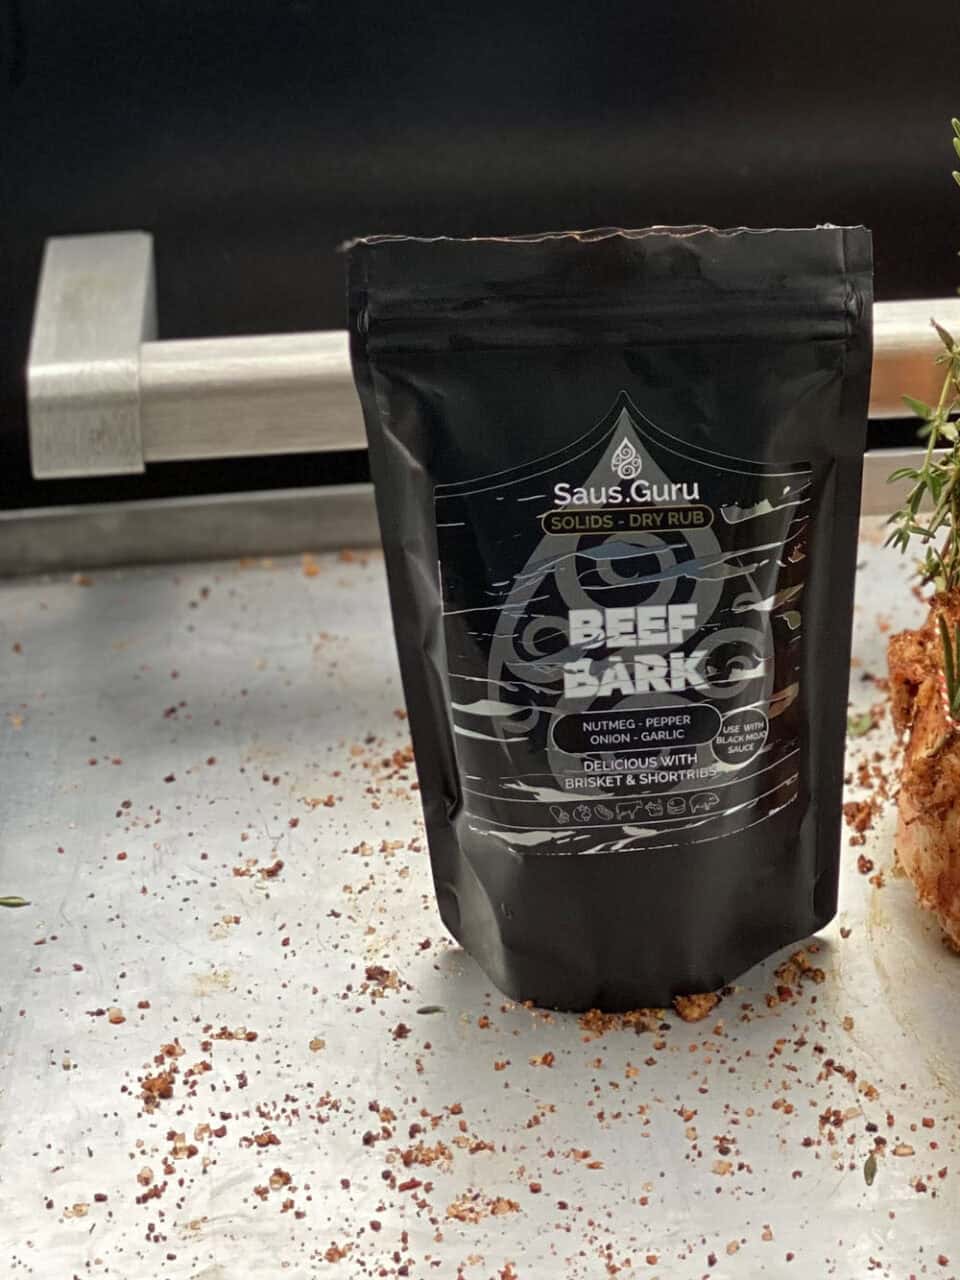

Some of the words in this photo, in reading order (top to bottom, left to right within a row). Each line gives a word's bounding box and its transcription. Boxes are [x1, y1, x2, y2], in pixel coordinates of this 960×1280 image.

[554, 479, 700, 505] Saus.Guru
[551, 514, 614, 530] SOLIDS
[629, 512, 665, 528] DRY
[668, 511, 705, 526] RUB
[569, 603, 698, 650] BEEF
[564, 650, 711, 699] BARK
[582, 719, 636, 732] NUTMEG
[646, 715, 691, 728] PEPPER
[723, 725, 740, 734] USE
[743, 721, 764, 732] WITH
[590, 732, 630, 745] ONION
[641, 729, 685, 742] GARLIC
[716, 735, 744, 745] BLACK
[745, 730, 767, 741] MOJO
[727, 743, 754, 754] SAUCE
[584, 756, 657, 772] DELICIOUS
[660, 753, 698, 767] WITH
[565, 775, 623, 790] BRISKET
[626, 772, 636, 786] &
[639, 766, 717, 785] SHORTRIBS
